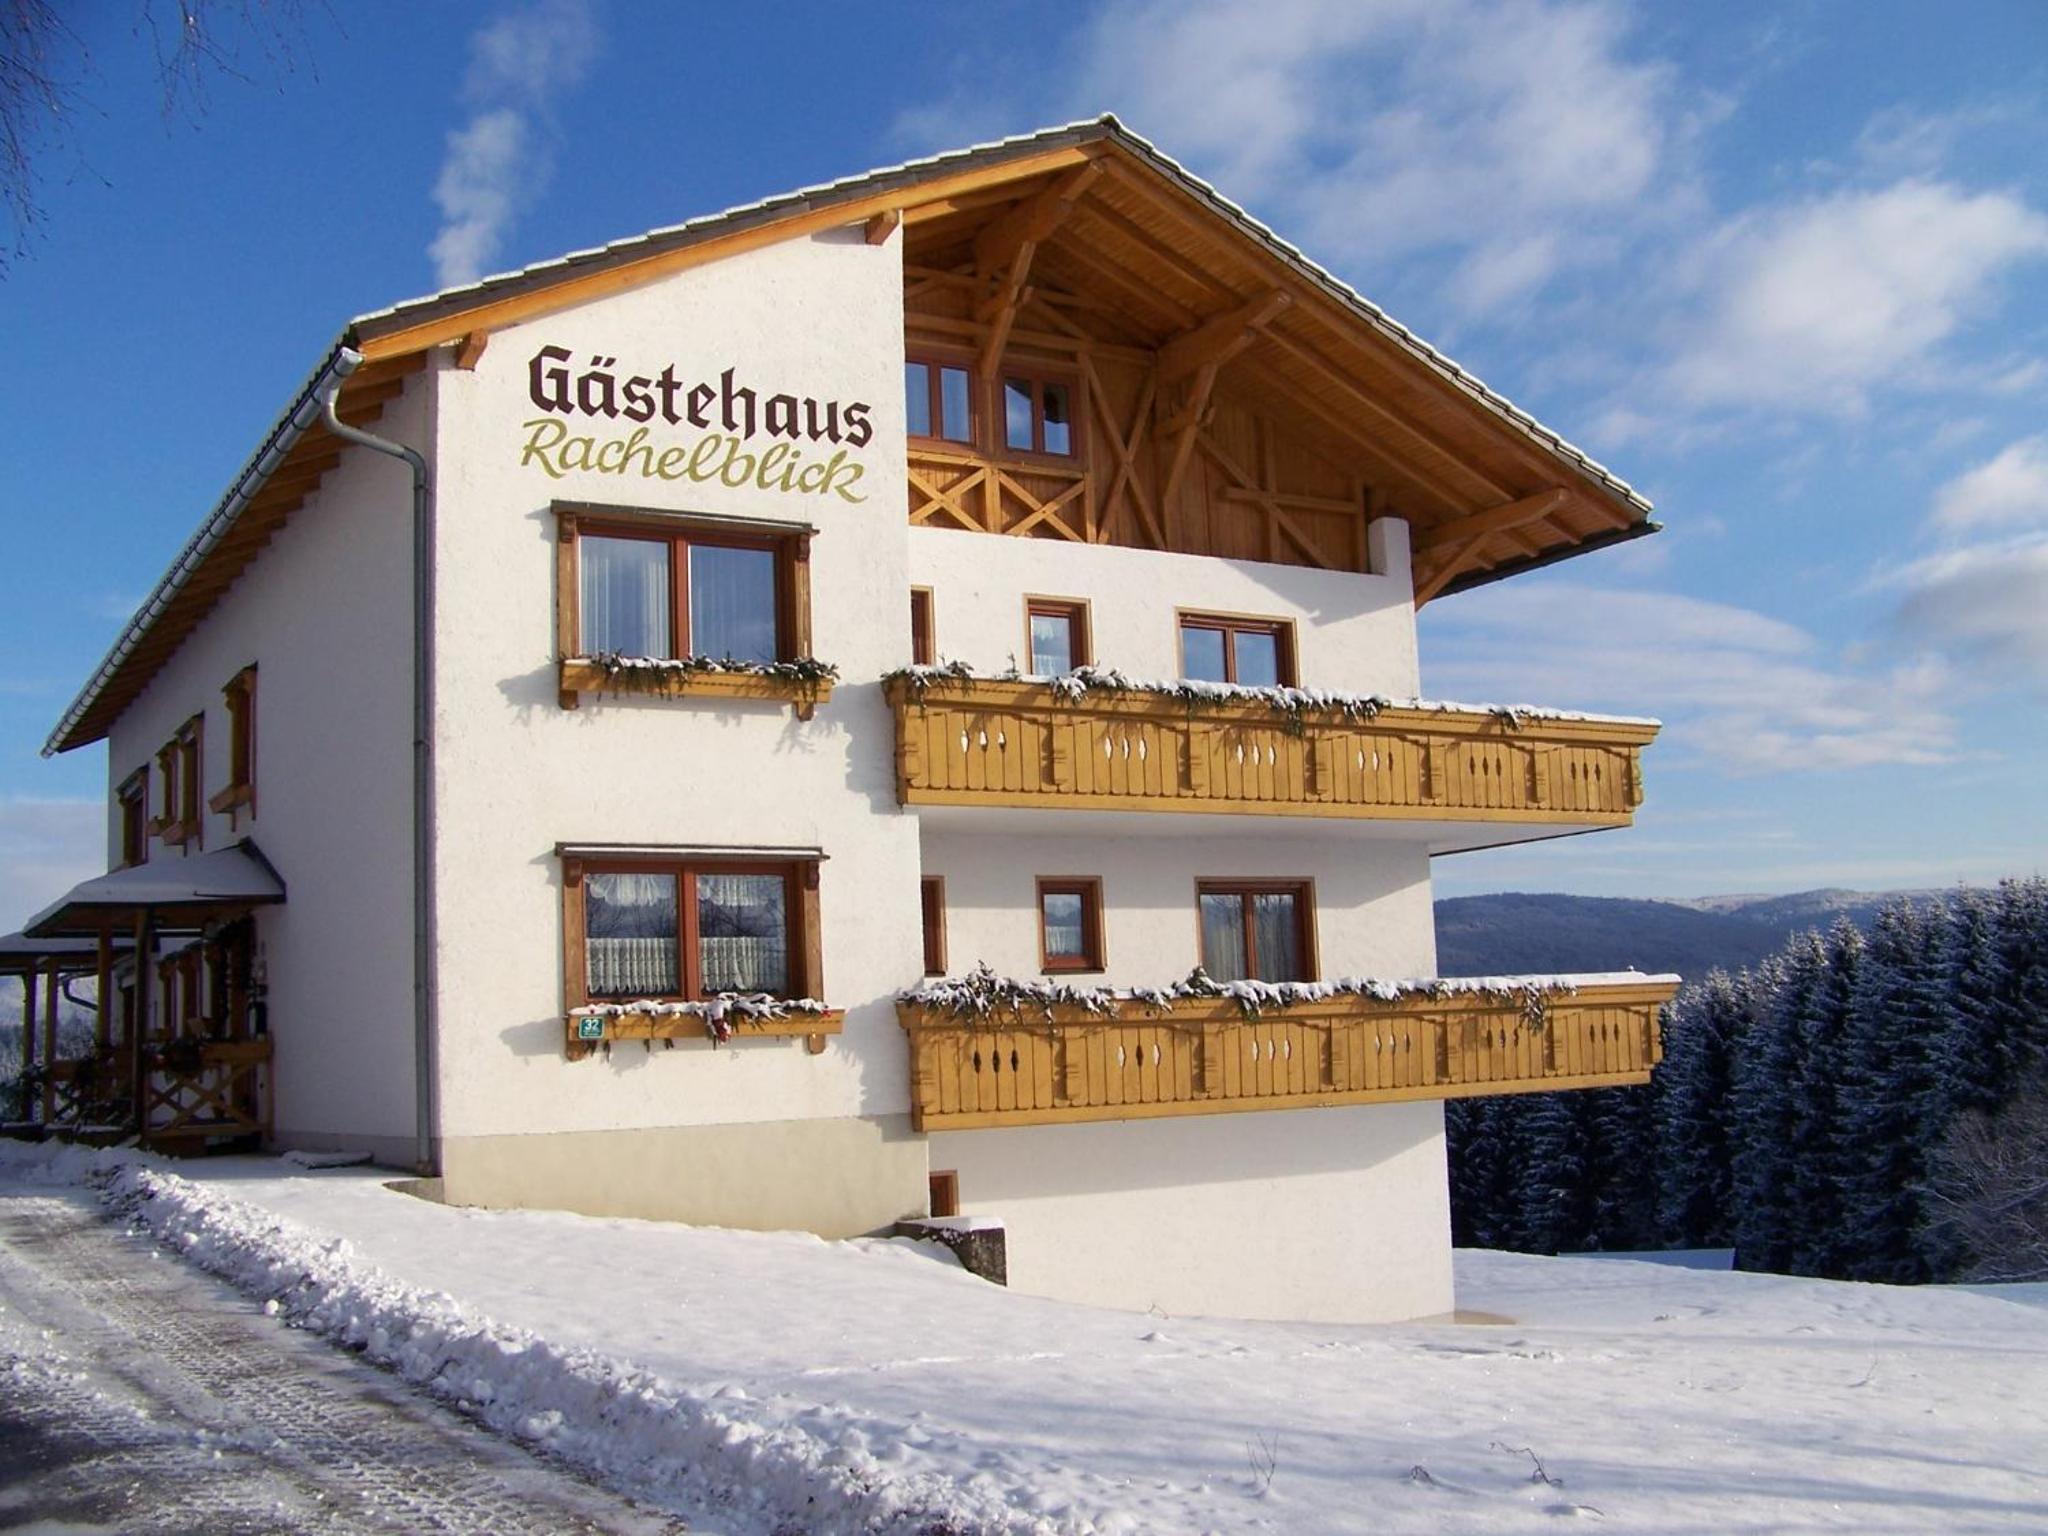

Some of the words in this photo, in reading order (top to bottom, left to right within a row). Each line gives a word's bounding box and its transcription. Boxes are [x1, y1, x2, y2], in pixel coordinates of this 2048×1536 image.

[528, 345, 873, 448] Gästehaus
[520, 418, 869, 504] Rachelblick
[584, 1019, 599, 1031] 32
